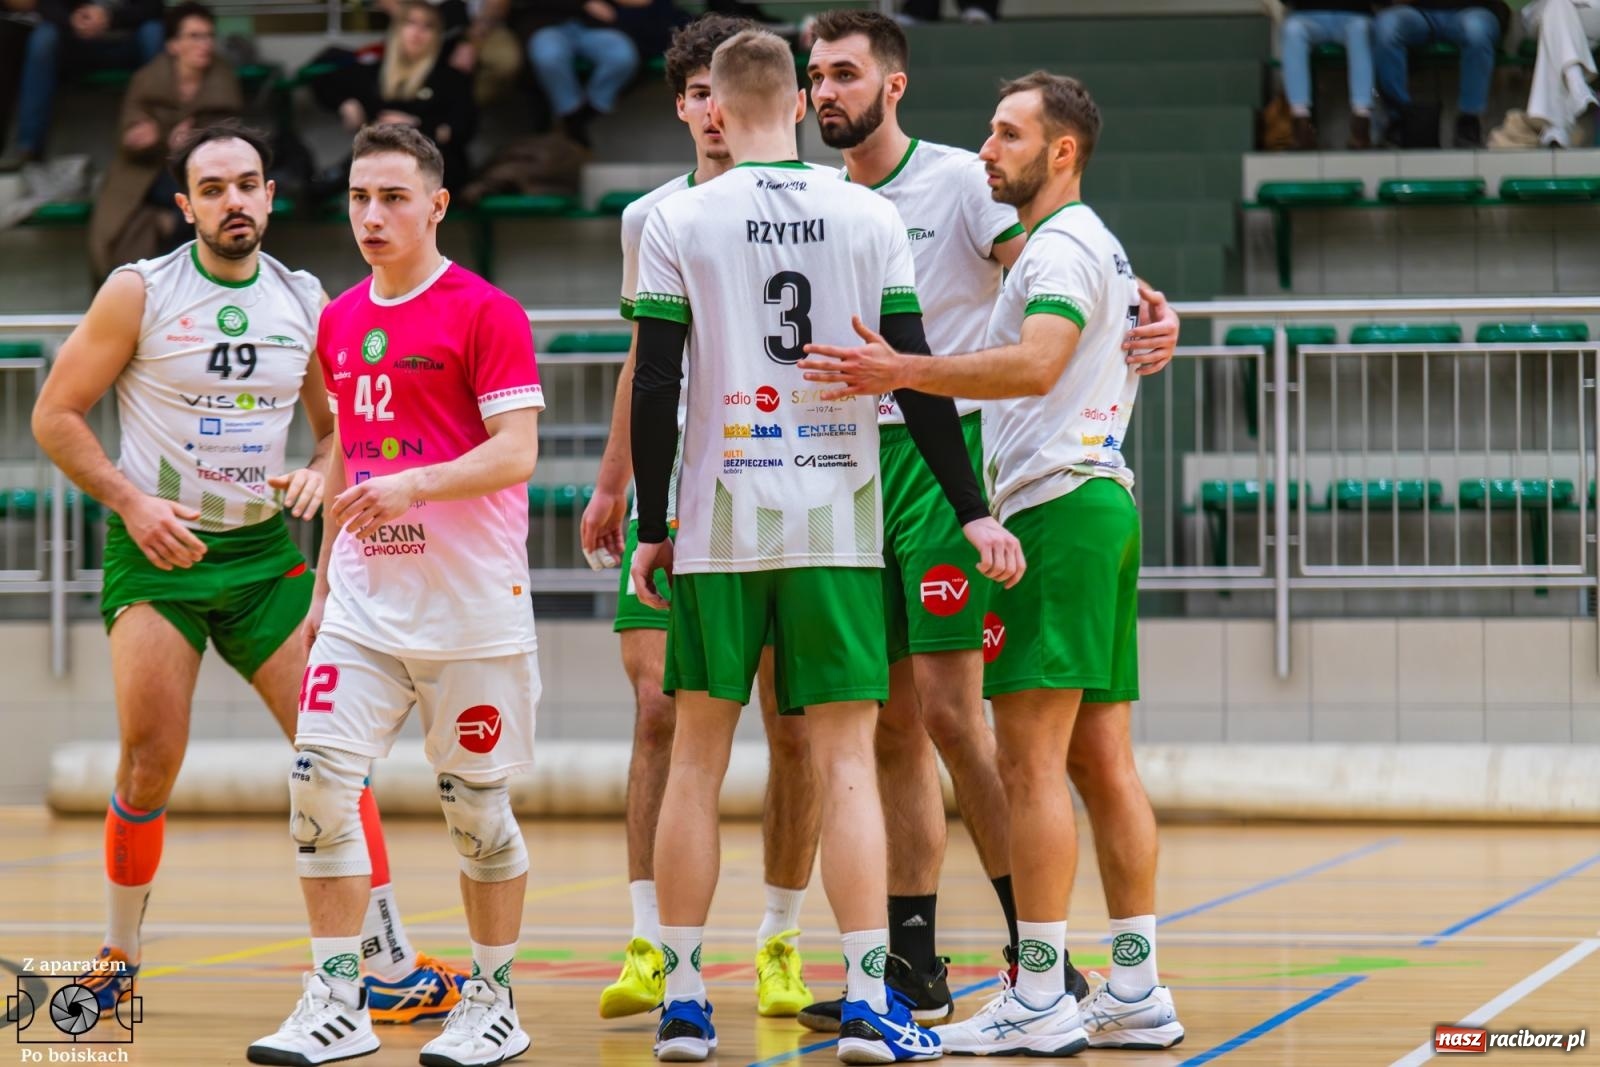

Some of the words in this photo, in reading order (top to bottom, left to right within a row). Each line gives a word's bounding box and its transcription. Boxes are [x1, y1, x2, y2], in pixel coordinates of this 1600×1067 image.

[746, 219, 825, 244] RZYTKI
[764, 271, 812, 365] 3
[206, 342, 257, 380] 49
[354, 374, 395, 422] 42
[798, 424, 857, 437] ENTECO
[818, 460, 858, 468] automatic
[920, 580, 969, 603] RV
[456, 713, 501, 740] RV
